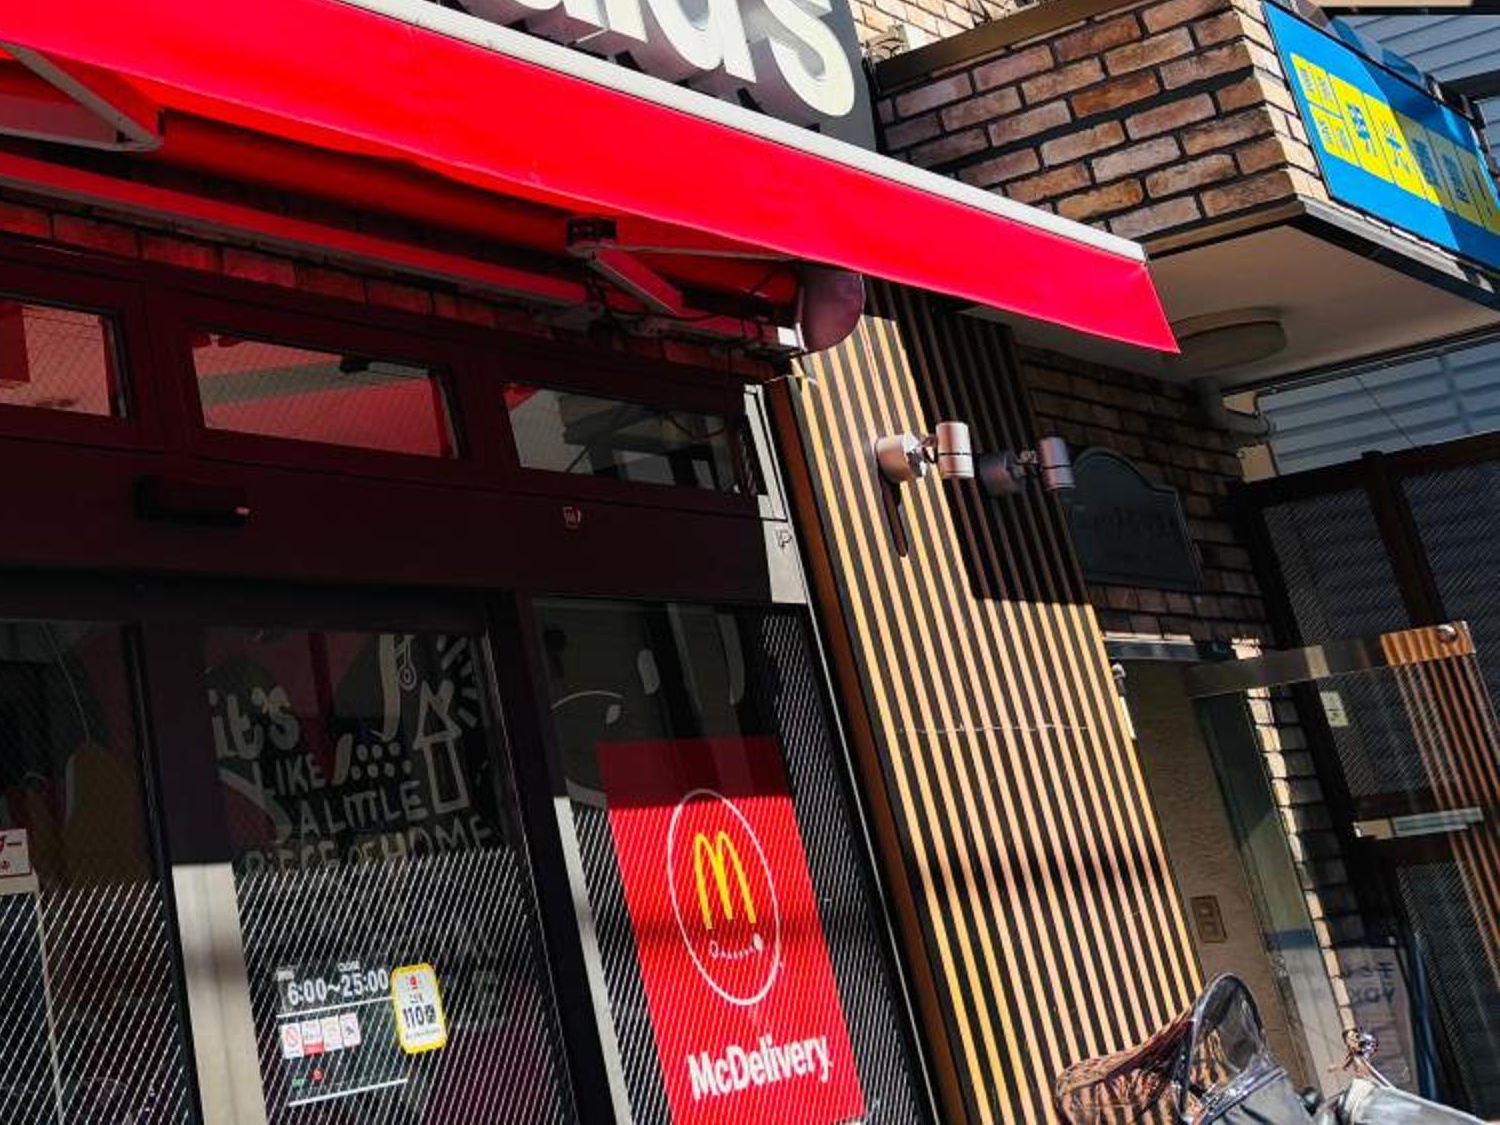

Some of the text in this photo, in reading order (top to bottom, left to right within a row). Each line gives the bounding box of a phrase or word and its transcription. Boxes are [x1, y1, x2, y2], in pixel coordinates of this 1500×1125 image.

[252, 752, 327, 795] LIKE
[298, 779, 429, 840] A LITTLE
[686, 1033, 831, 1102] McDelivery
